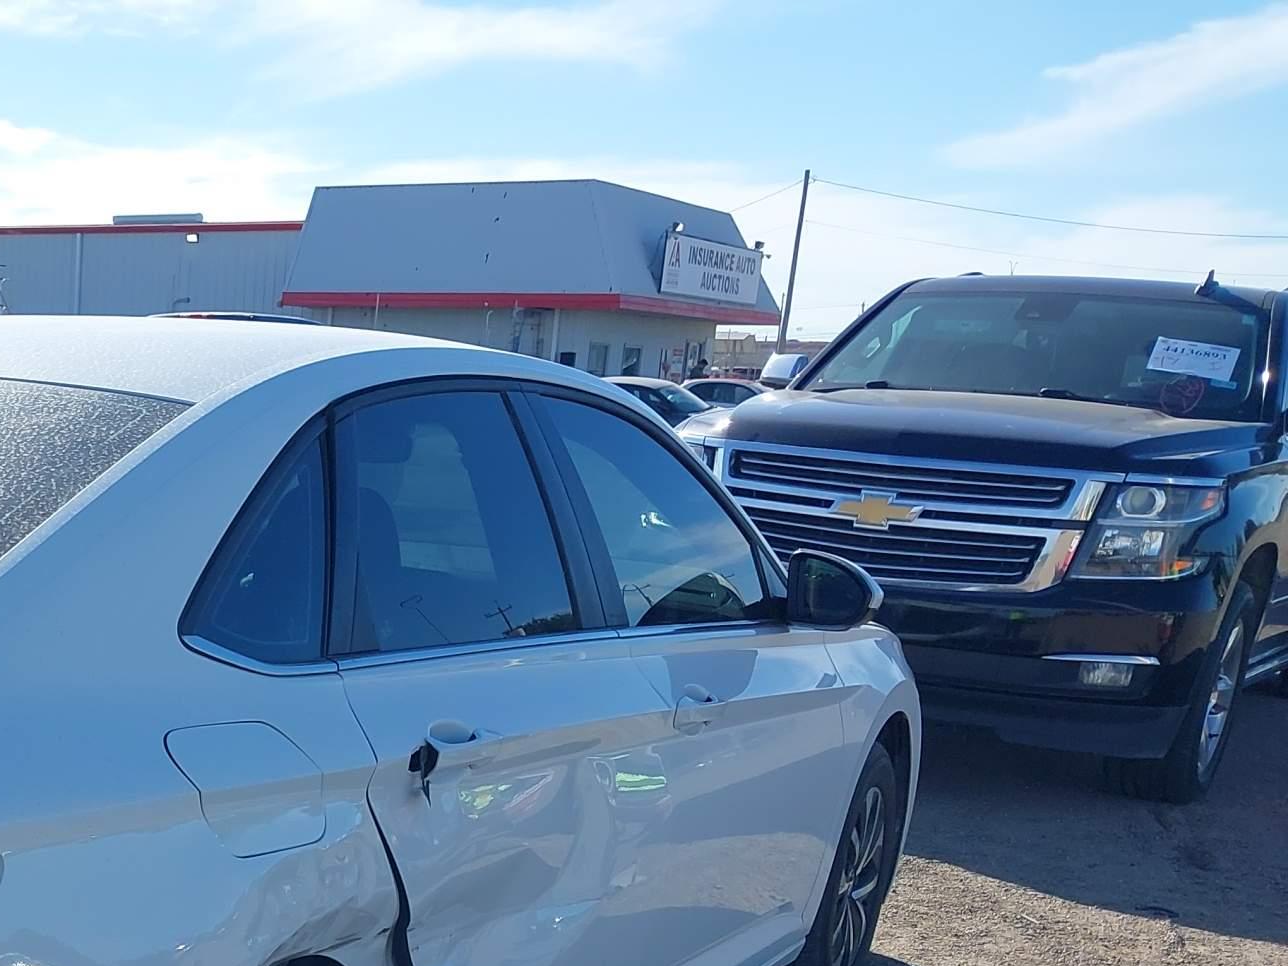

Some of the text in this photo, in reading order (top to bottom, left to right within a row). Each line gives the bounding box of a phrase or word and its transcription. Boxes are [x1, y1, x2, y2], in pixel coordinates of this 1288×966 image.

[688, 246, 757, 275] INSURANCE AUTO
[700, 271, 740, 295] AUCTIONS
